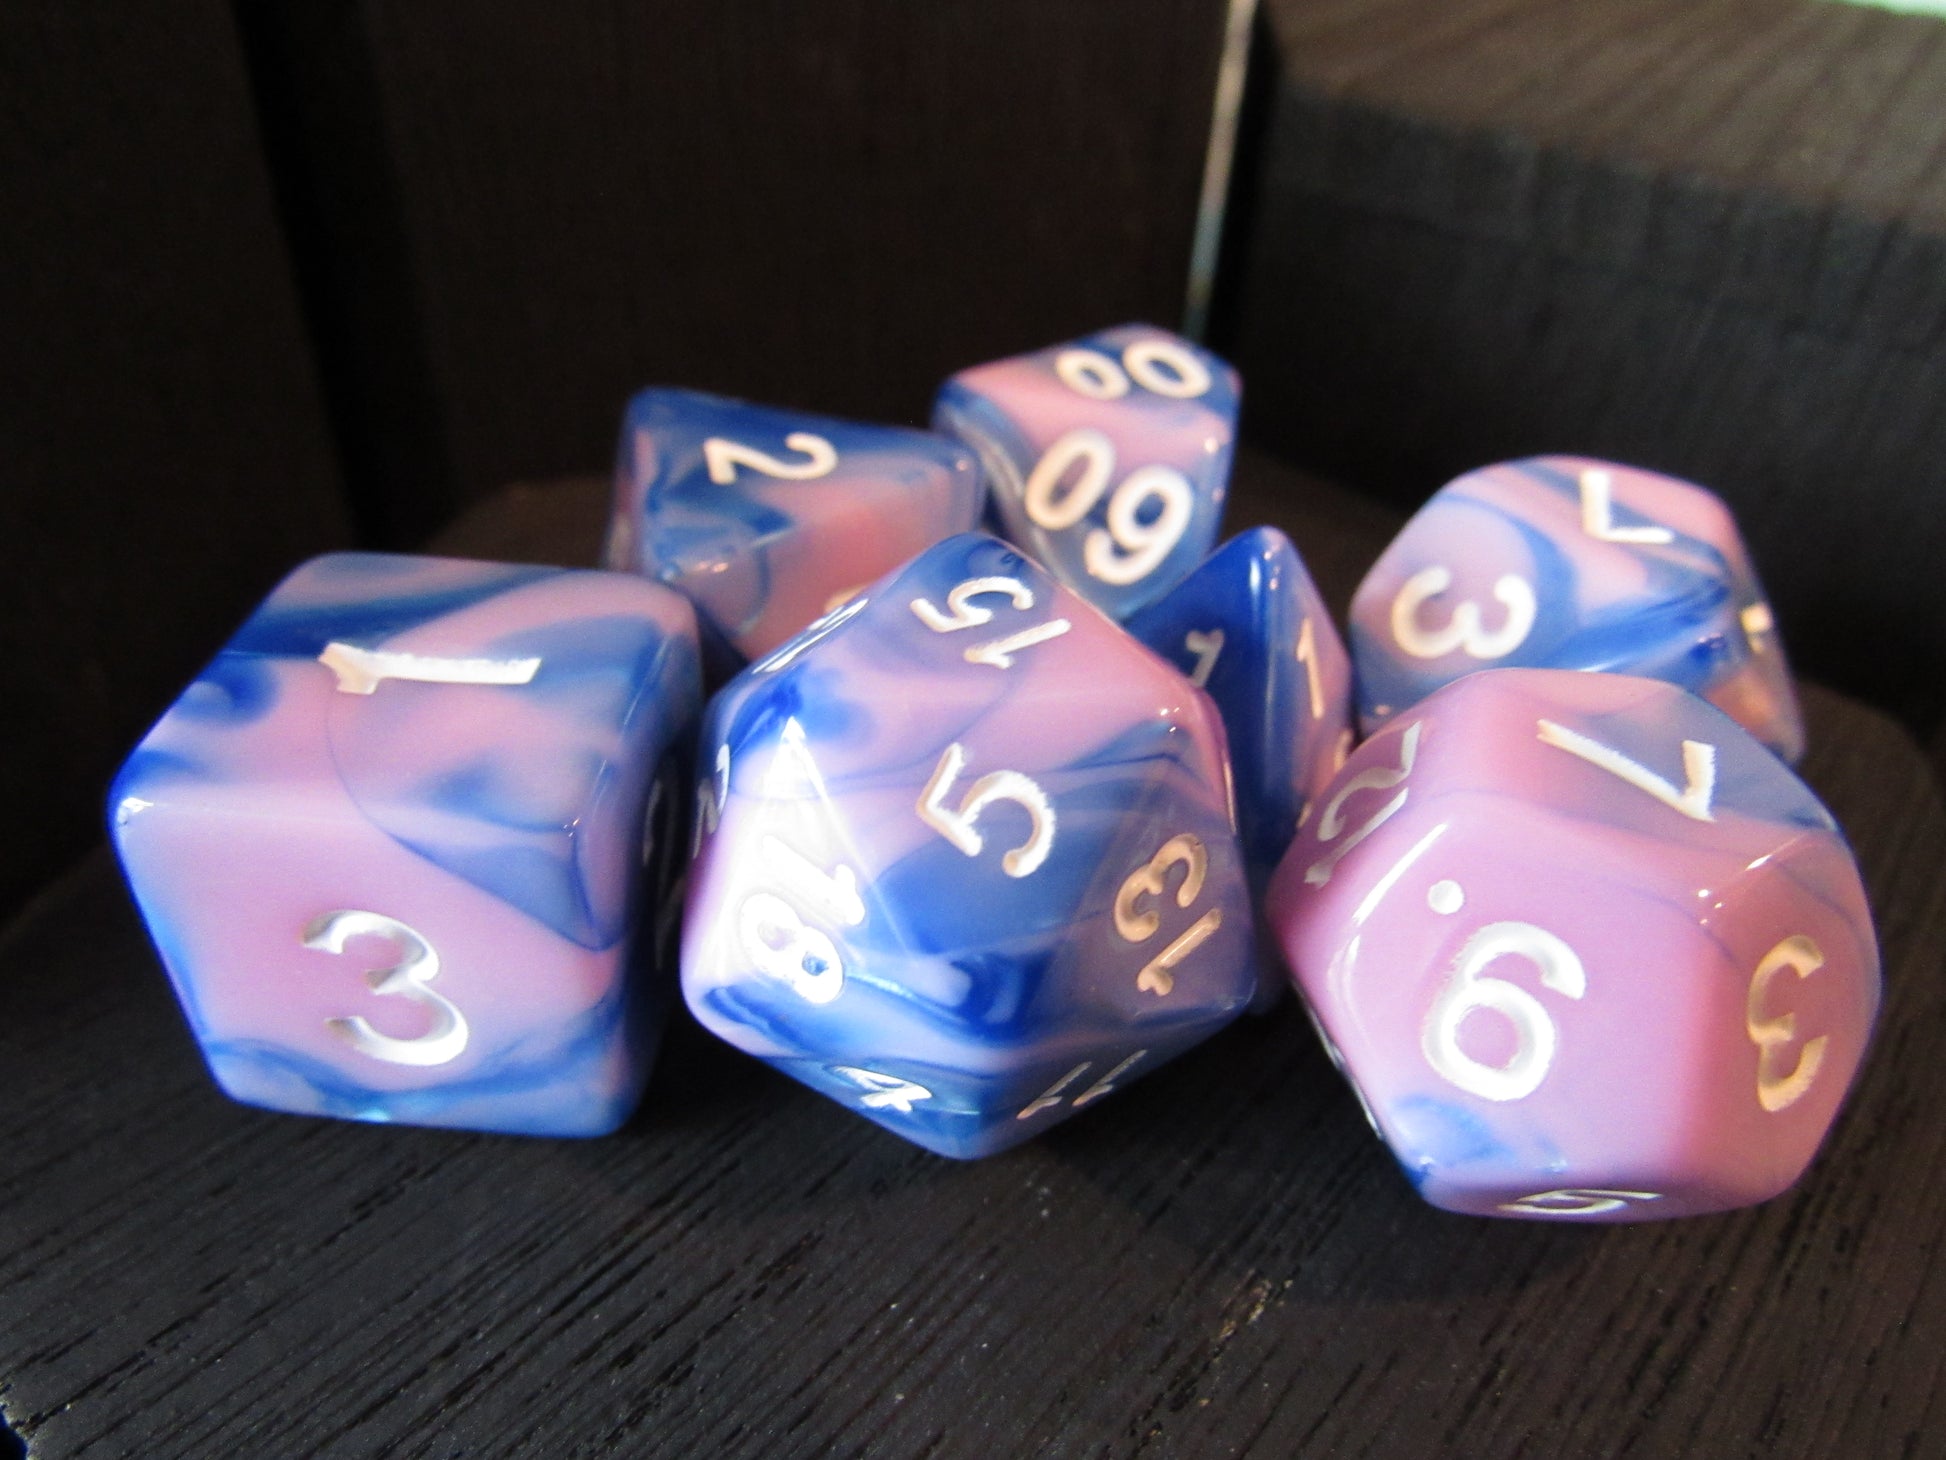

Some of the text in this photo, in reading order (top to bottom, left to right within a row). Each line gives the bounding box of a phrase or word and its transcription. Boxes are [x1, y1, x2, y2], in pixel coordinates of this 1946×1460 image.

[704, 433, 838, 485] 2
[911, 576, 1072, 670] 15
[1391, 566, 1537, 659] 3
[318, 642, 542, 695] 1
[1296, 618, 1325, 720] 1
[916, 743, 1056, 878] 5
[1537, 719, 1716, 822] 7
[740, 834, 866, 1004] 18
[1114, 833, 1222, 996] 13
[303, 909, 469, 1066] 3
[1747, 935, 1828, 1112] 3
